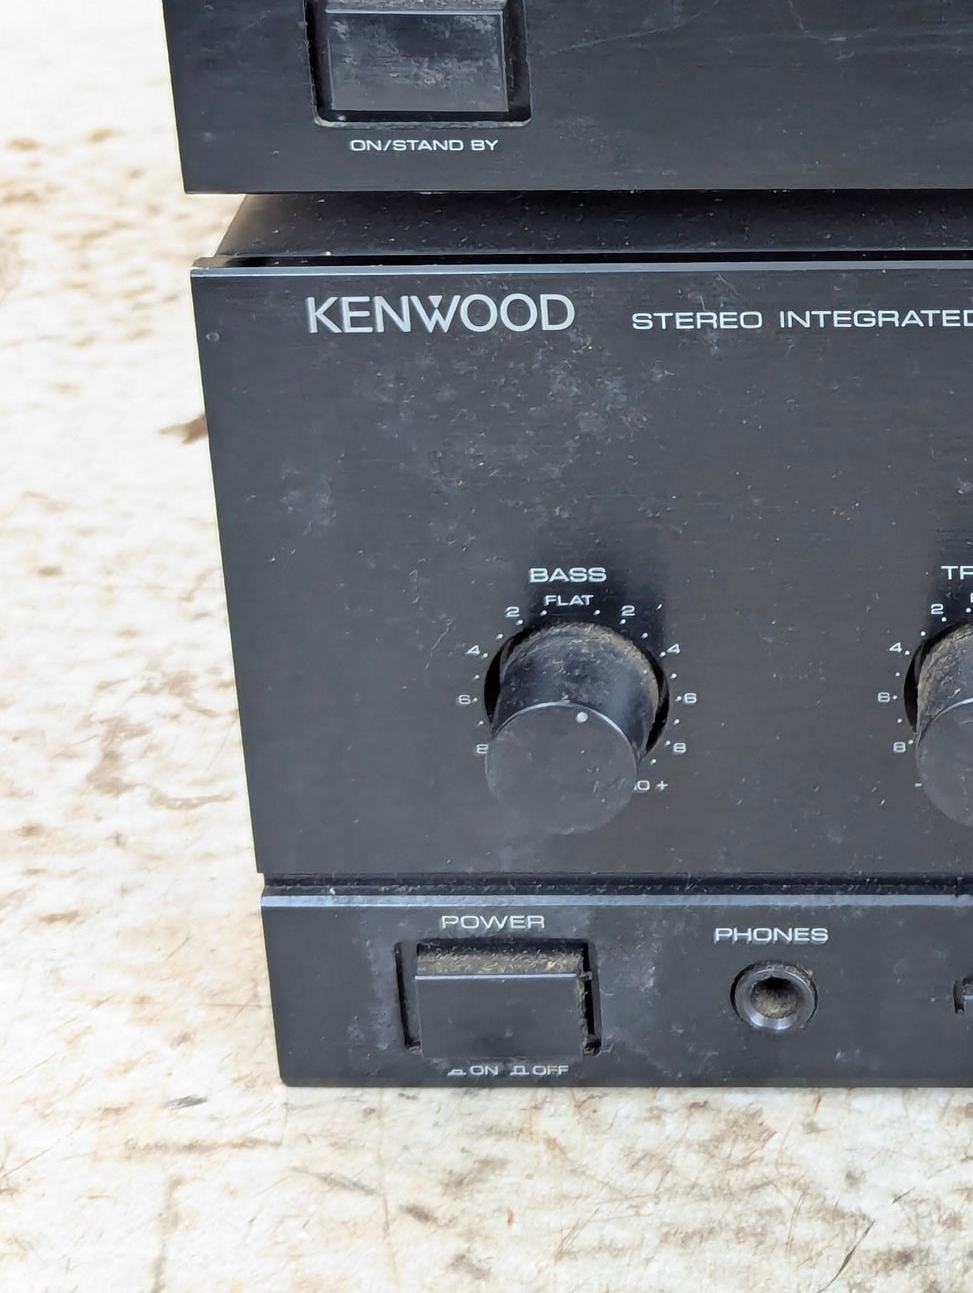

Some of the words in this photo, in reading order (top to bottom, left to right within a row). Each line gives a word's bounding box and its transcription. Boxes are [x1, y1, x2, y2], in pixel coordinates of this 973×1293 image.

[350, 139, 464, 152] ON/STAND
[470, 139, 499, 151] BY
[306, 293, 575, 334] KENWOOD
[631, 311, 763, 330] STEREO
[529, 567, 607, 583] BASS
[544, 594, 594, 606] FLAT
[505, 606, 520, 618] 2
[621, 605, 636, 617] 2
[930, 603, 944, 615] 2
[466, 645, 481, 655] 4
[667, 643, 681, 654] 4
[889, 642, 903, 653] 4
[457, 694, 472, 705] 6
[683, 692, 697, 704] 6
[673, 742, 687, 754] 8
[893, 741, 906, 753] 8
[441, 915, 545, 930] POWER
[714, 927, 829, 942] PHONES
[469, 1065, 499, 1076] ON
[532, 1065, 569, 1076] OFF
